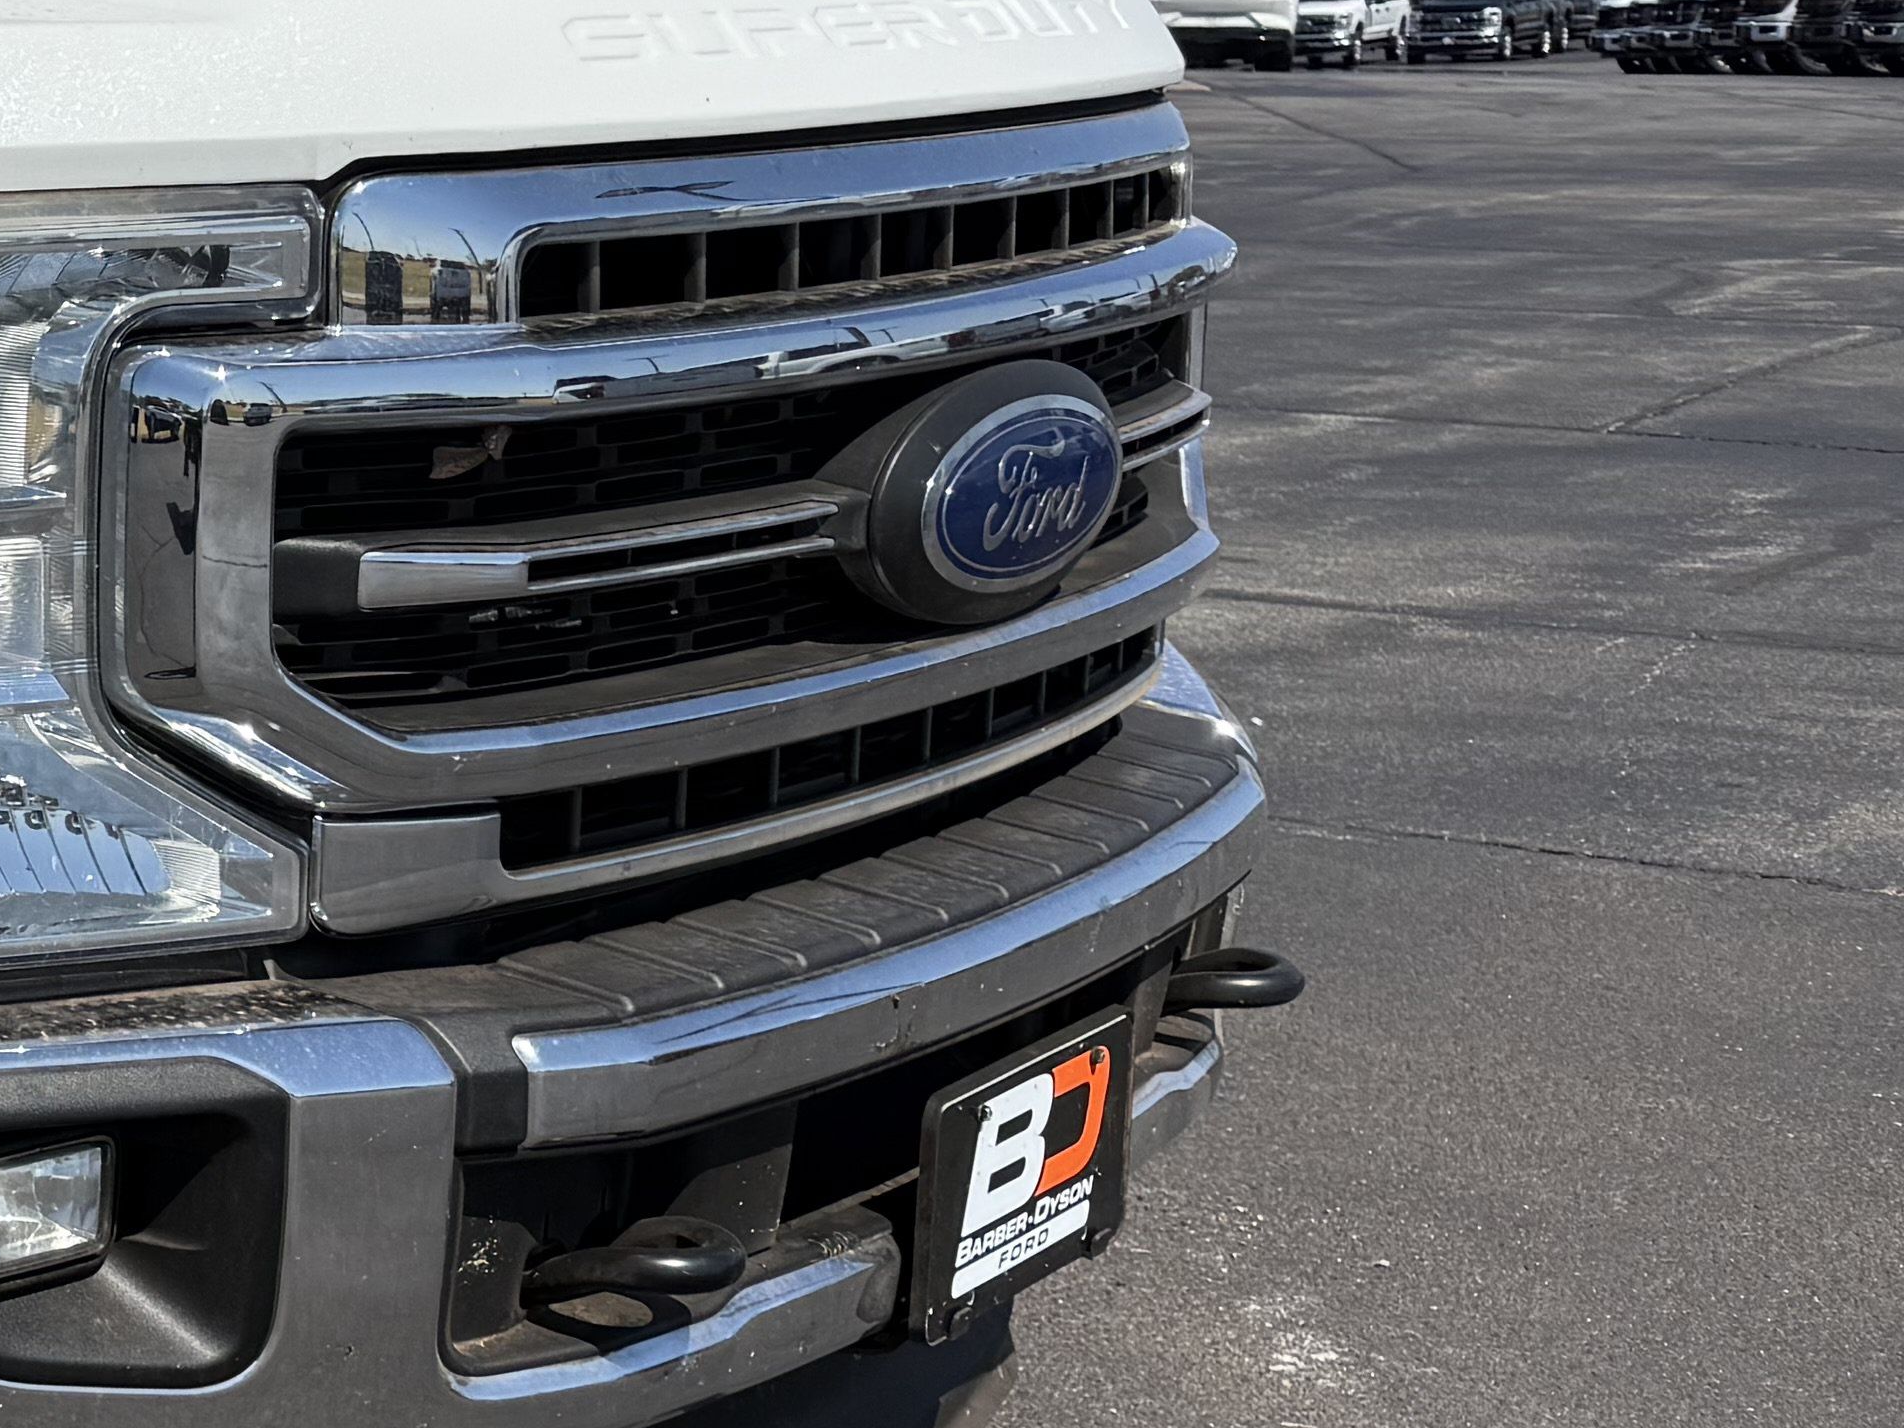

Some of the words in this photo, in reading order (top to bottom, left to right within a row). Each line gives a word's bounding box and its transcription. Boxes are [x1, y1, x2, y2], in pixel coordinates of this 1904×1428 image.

[560, 0, 959, 62] SUPER
[982, 427, 1090, 552] Ford
[998, 1227, 1050, 1269] FORD
